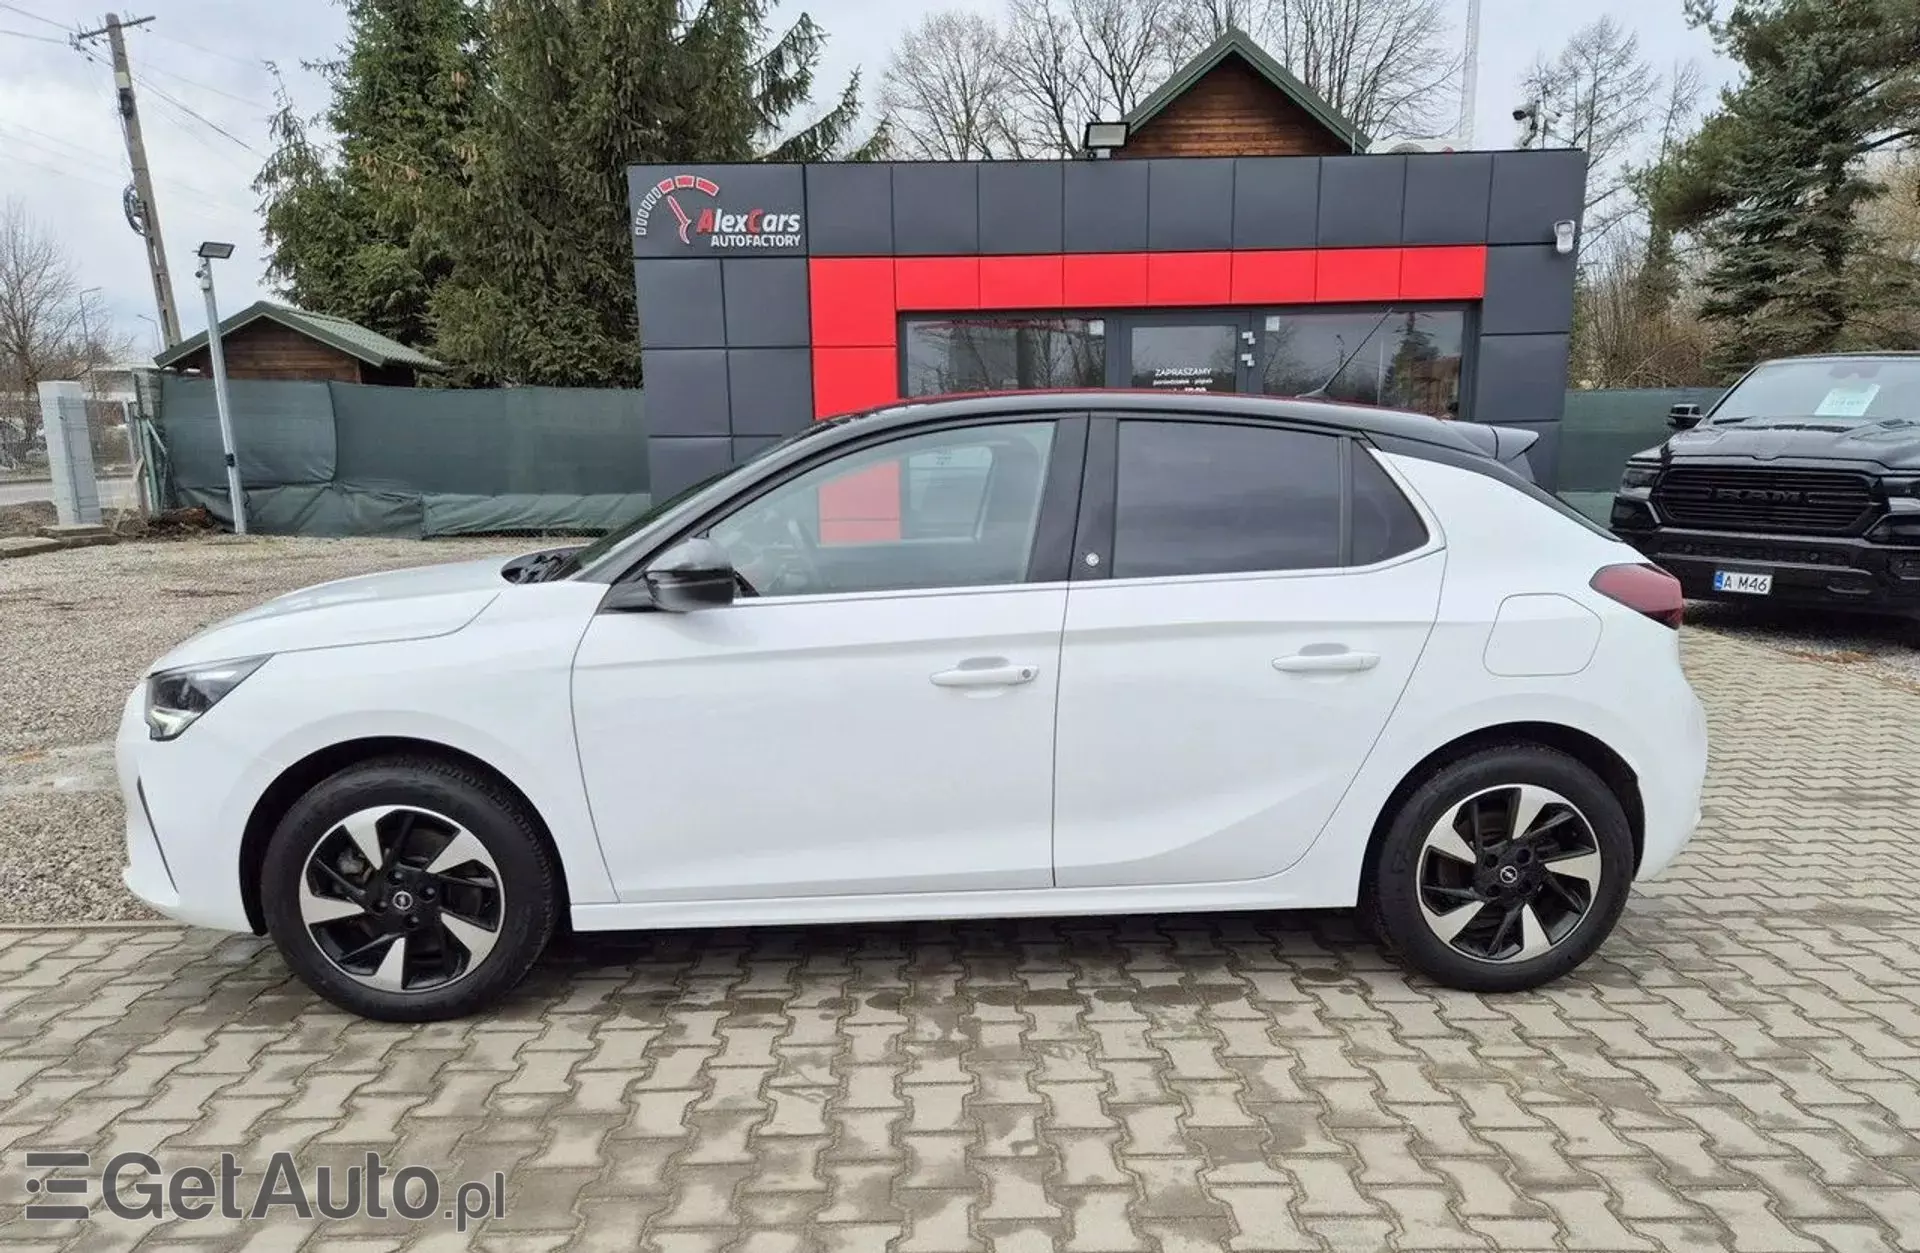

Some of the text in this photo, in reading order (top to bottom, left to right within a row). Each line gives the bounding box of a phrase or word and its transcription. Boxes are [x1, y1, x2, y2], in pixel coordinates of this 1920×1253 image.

[696, 208, 801, 234] AlexCars
[711, 234, 801, 247] AUTOFACTORY
[1154, 367, 1212, 377] ZAPRASZAMY
[1723, 575, 1768, 592] A M46
